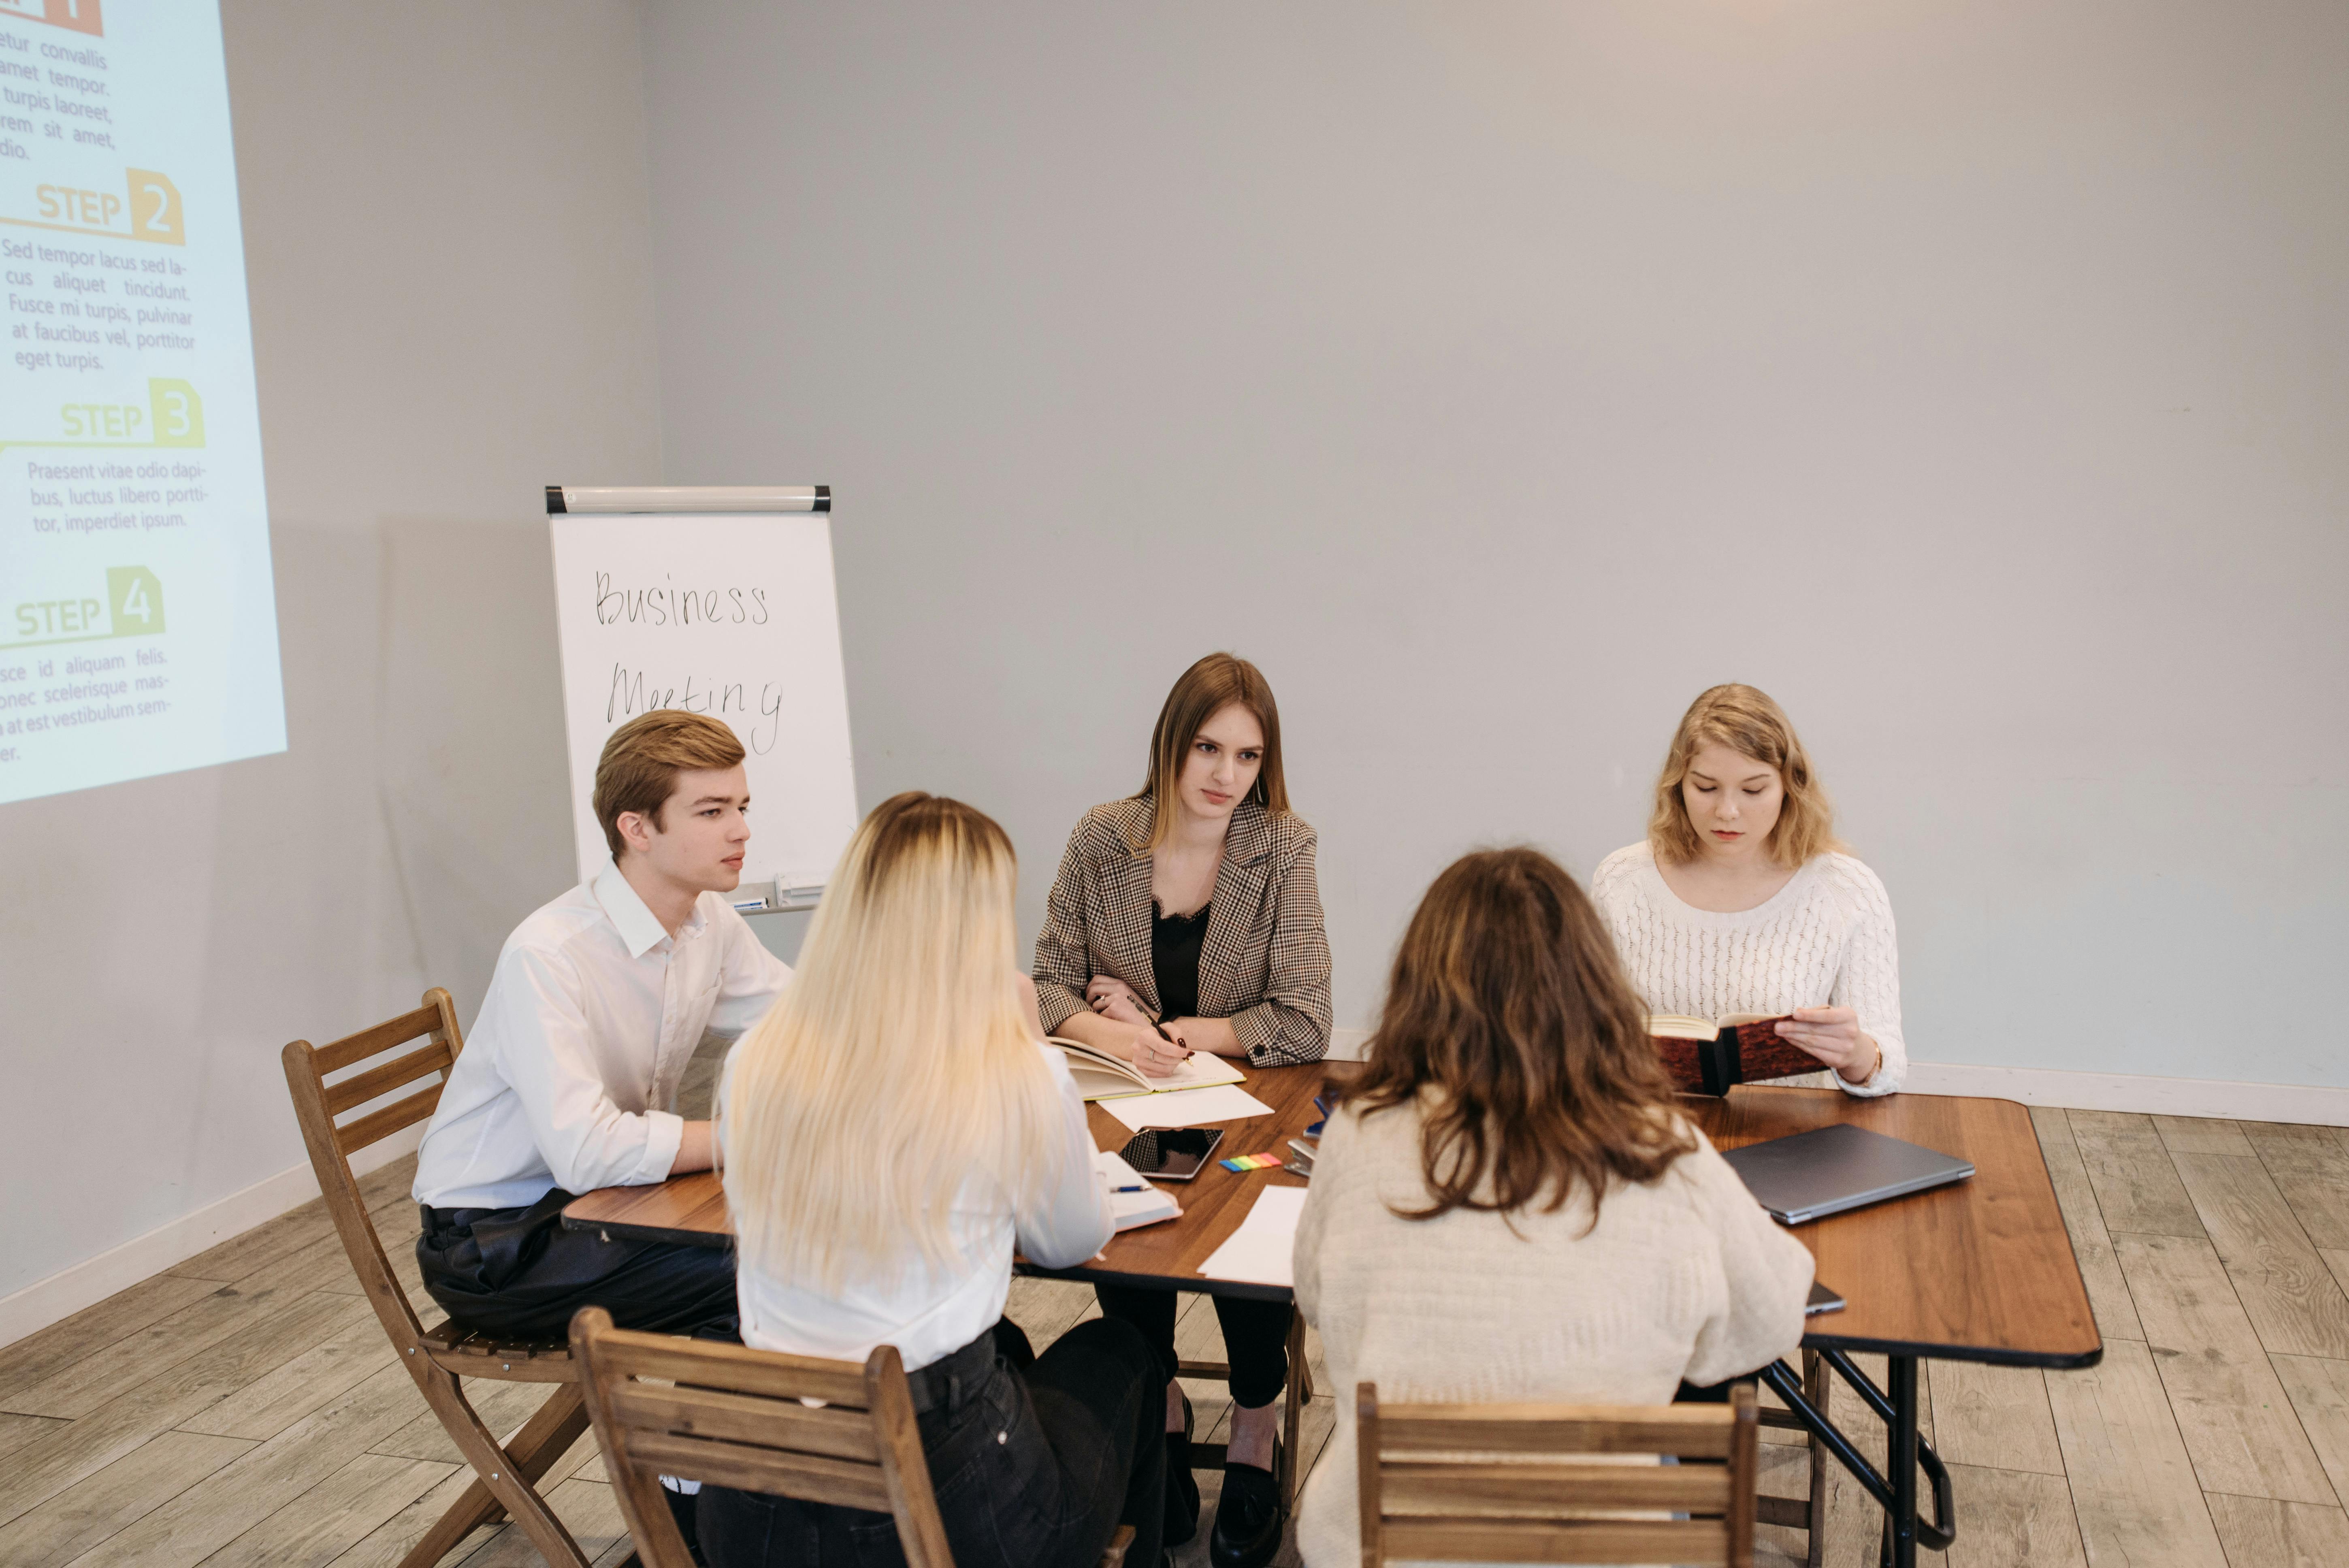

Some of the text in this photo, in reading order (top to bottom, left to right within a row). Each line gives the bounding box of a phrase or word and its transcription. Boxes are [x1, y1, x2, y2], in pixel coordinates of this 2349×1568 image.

[40, 42, 108, 70] convallis
[48, 68, 110, 96] tempor.
[3, 85, 113, 124] turpis laoreet,
[43, 120, 63, 139] sit
[73, 128, 115, 150] amet,
[36, 184, 172, 232] STEP 2
[3, 239, 187, 275] Sed tempor lacus sed la-
[5, 270, 190, 301] cus aliquet tincidunt.
[9, 294, 192, 326] Fusce mi turpis, pulvinar
[12, 322, 194, 350] at faucibus vel, porttitor
[15, 352, 104, 373] eget turpis.
[61, 391, 190, 437] STEP 3
[28, 462, 207, 482] Praesent vitae odio dapi-
[30, 486, 209, 508] bus, luctus libero portti-
[34, 513, 187, 534] tor, imperdiet ipsum.
[15, 578, 151, 636] STEP 4
[596, 571, 768, 626] Business
[38, 660, 53, 677] id
[66, 656, 125, 676] aliquam
[136, 648, 168, 665] felis.
[44, 681, 128, 703] scelerisque
[135, 675, 170, 690] mas-
[7, 717, 23, 735] at
[26, 714, 51, 732] est
[52, 703, 134, 727] vestibulum
[137, 699, 171, 715] sem-
[608, 663, 782, 755] Meeting
